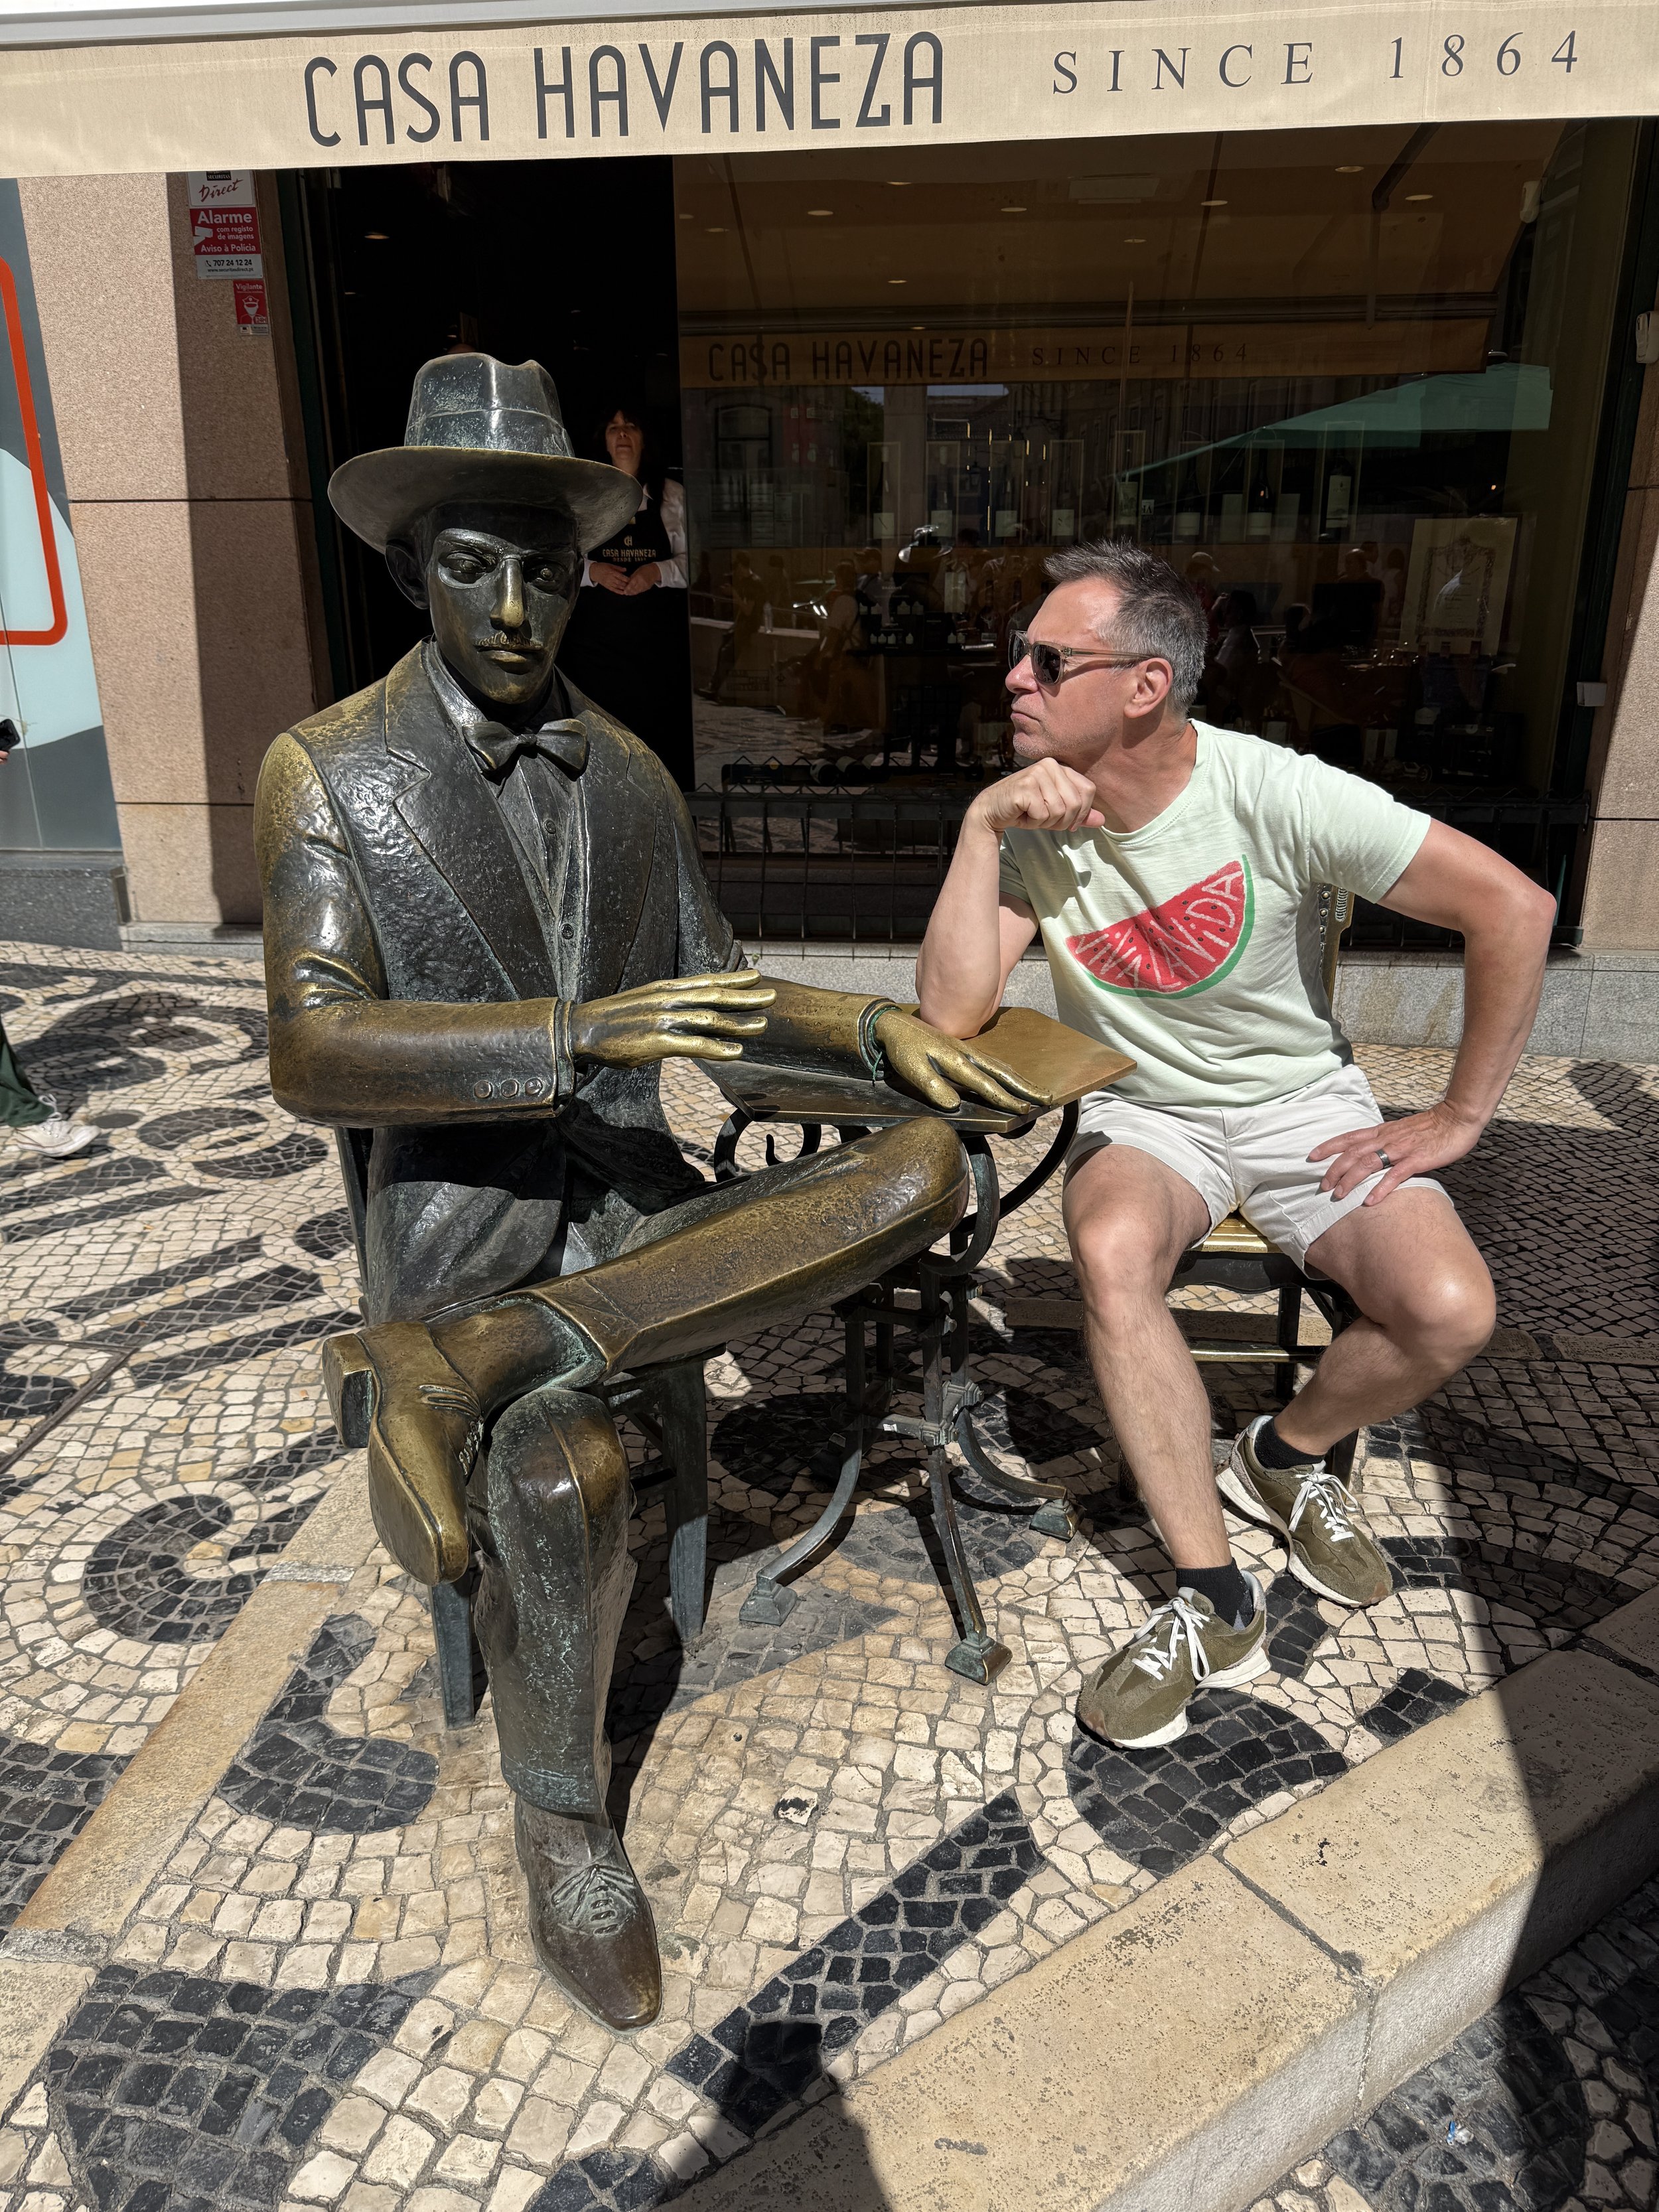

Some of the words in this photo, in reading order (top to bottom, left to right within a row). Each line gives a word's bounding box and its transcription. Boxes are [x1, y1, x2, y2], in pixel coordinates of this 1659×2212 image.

[304, 50, 490, 147] CASA
[534, 31, 943, 139] HAVANEZA
[1052, 41, 1315, 95] SINCE
[1389, 29, 1578, 79] 1864
[198, 178, 244, 202] Direct
[197, 209, 253, 224] Alarme
[708, 342, 791, 382] CASA
[812, 337, 988, 380] HAVANEZA
[1032, 345, 1141, 366] SINCE
[1171, 342, 1247, 363] 1864
[621, 549, 656, 557] HAVANEZA
[1144, 928, 1200, 990] LA
